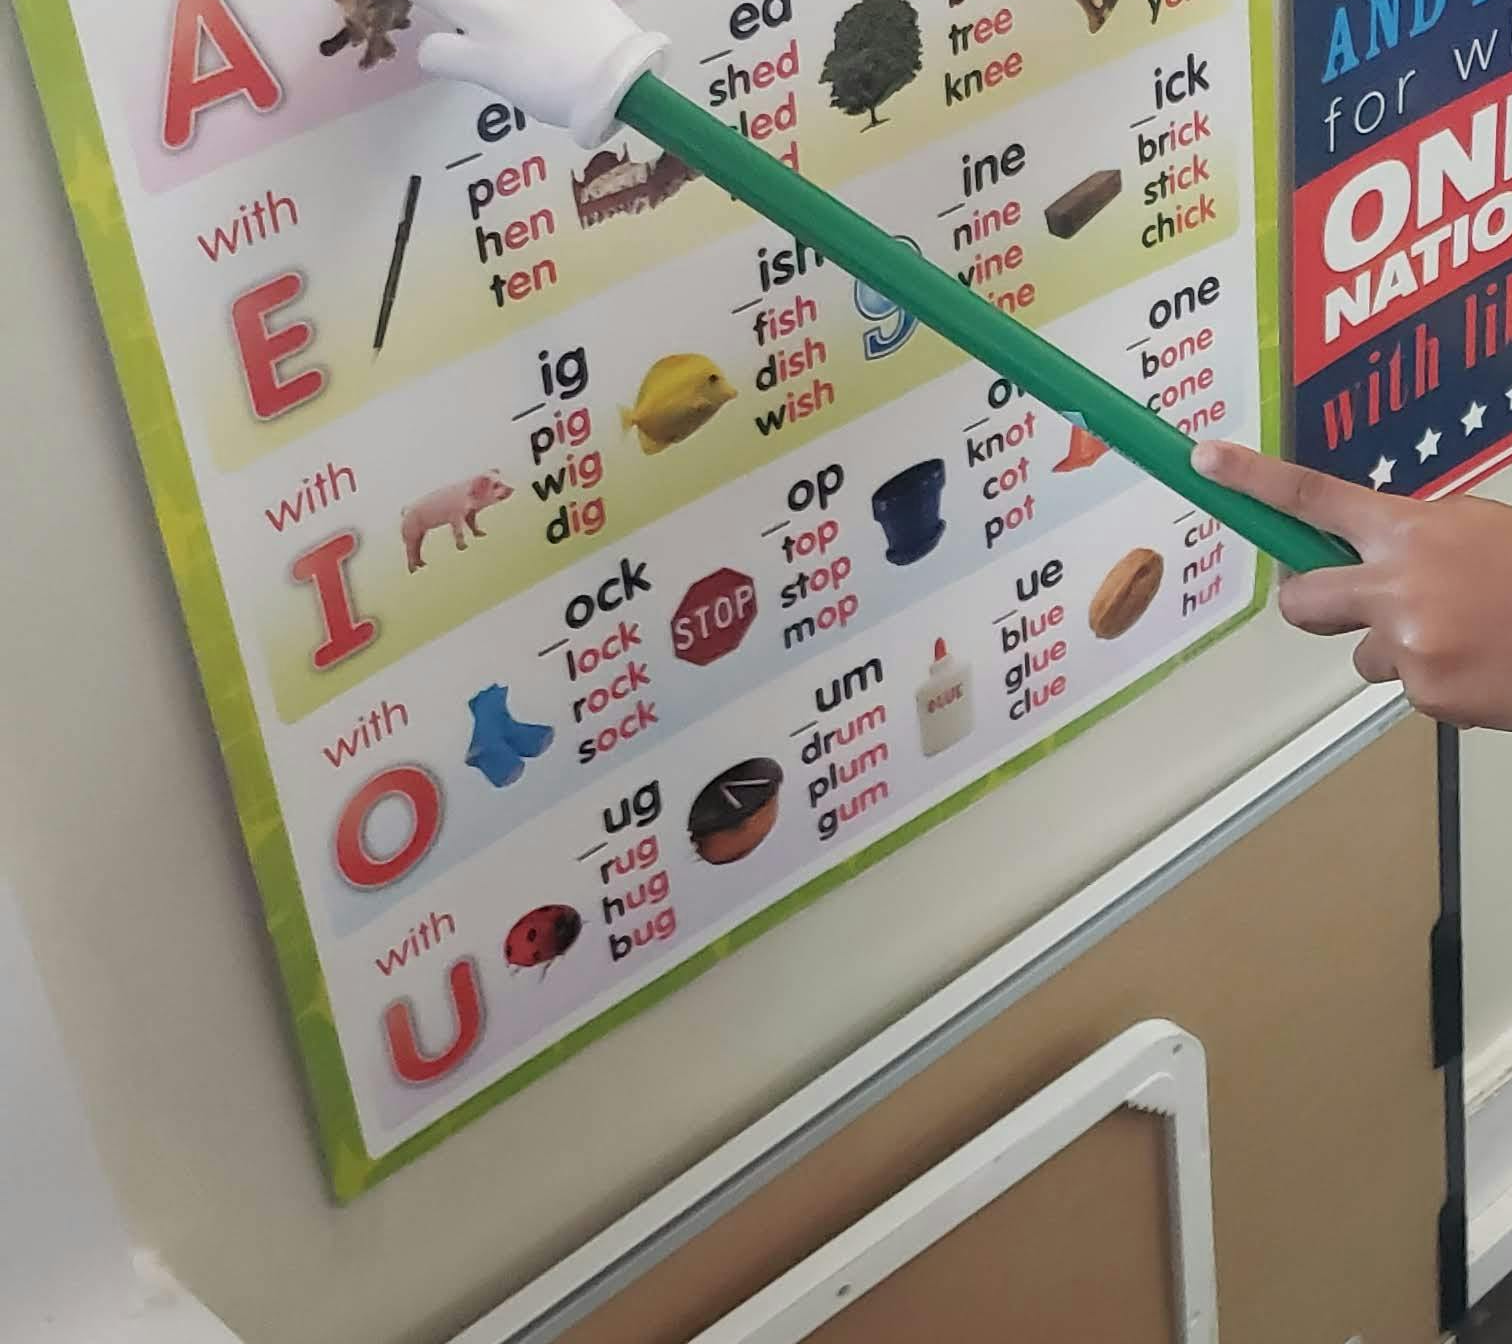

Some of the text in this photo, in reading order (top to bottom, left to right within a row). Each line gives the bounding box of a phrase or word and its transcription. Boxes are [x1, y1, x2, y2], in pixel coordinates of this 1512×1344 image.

[948, 8, 1013, 56] tree
[709, 39, 799, 106] shed
[944, 52, 1023, 107] knee
[729, 91, 797, 139] led
[1138, 110, 1211, 165] brick
[1324, 69, 1416, 153] for
[468, 155, 547, 220] pen
[1143, 154, 1211, 206] stick
[198, 190, 299, 263] with
[475, 208, 555, 264] hen
[953, 201, 1022, 252] nine
[1141, 193, 1217, 249] chick
[489, 259, 557, 308] ten
[957, 244, 1024, 288] vine
[231, 271, 328, 421] E
[753, 295, 817, 346] fish
[756, 338, 827, 391] dish
[1141, 328, 1214, 379] bone
[755, 379, 835, 436] wish
[1147, 367, 1214, 414] cone
[1323, 323, 1439, 451] with
[531, 407, 591, 466] pig
[966, 411, 1036, 468] knot
[265, 462, 357, 532] with
[532, 451, 603, 502] wig
[983, 456, 1029, 500] cot
[546, 497, 607, 544] dig
[781, 520, 839, 564] top
[984, 495, 1035, 549] pot
[781, 556, 852, 608] stop
[1183, 541, 1224, 584] nut
[291, 532, 376, 671] I
[674, 585, 754, 651] STOP
[784, 594, 859, 649] mop
[1182, 574, 1222, 616] hut
[566, 621, 642, 681] lock
[1002, 605, 1065, 653] blue
[573, 660, 651, 723] rock
[1004, 640, 1067, 694] glue
[1009, 675, 1066, 720] clue
[323, 700, 409, 768] with
[579, 700, 659, 764] sock
[802, 705, 886, 765] drum
[808, 742, 888, 808] plum
[336, 766, 441, 889] O
[818, 780, 889, 841] gum
[600, 836, 659, 884] rug
[602, 870, 670, 924] hug
[376, 912, 455, 976] with
[609, 907, 677, 962] bug
[384, 959, 482, 1084] U
